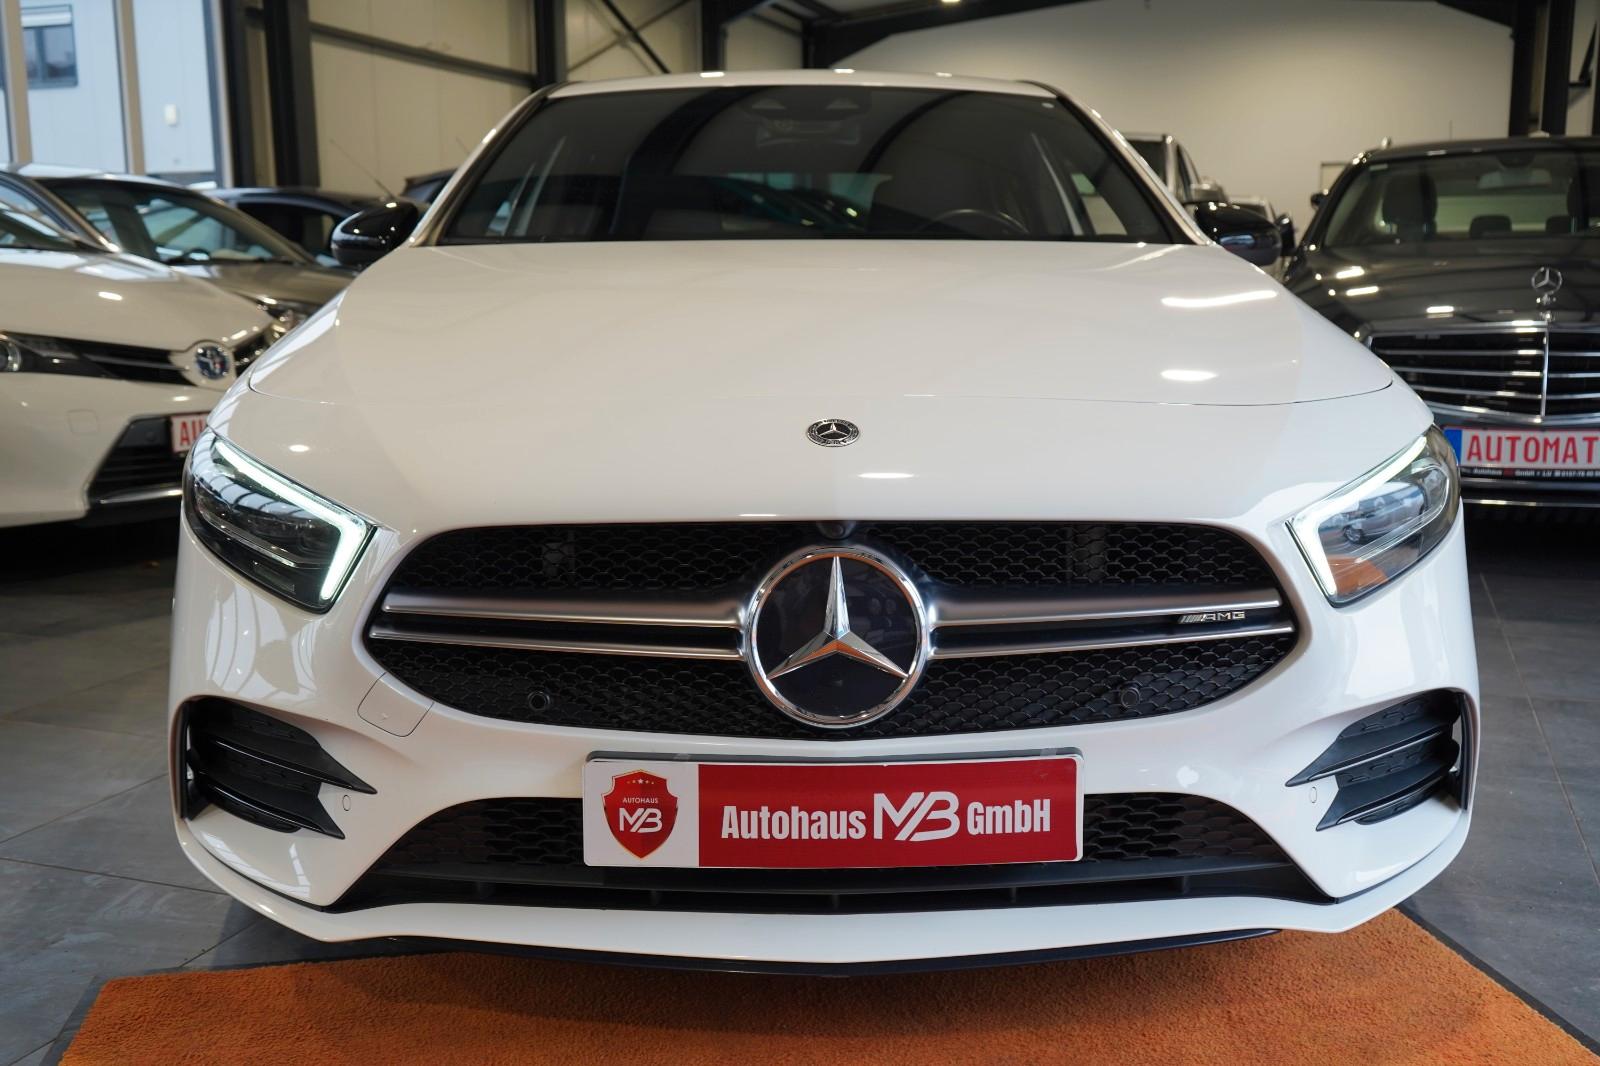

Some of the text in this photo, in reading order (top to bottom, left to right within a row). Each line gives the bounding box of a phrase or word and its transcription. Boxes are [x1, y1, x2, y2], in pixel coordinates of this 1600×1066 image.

[1467, 434, 1600, 465] AUTOMAT
[1198, 611, 1246, 622] AMG
[619, 807, 663, 833] MB
[721, 791, 1051, 842] Autohaus MB GmbH
